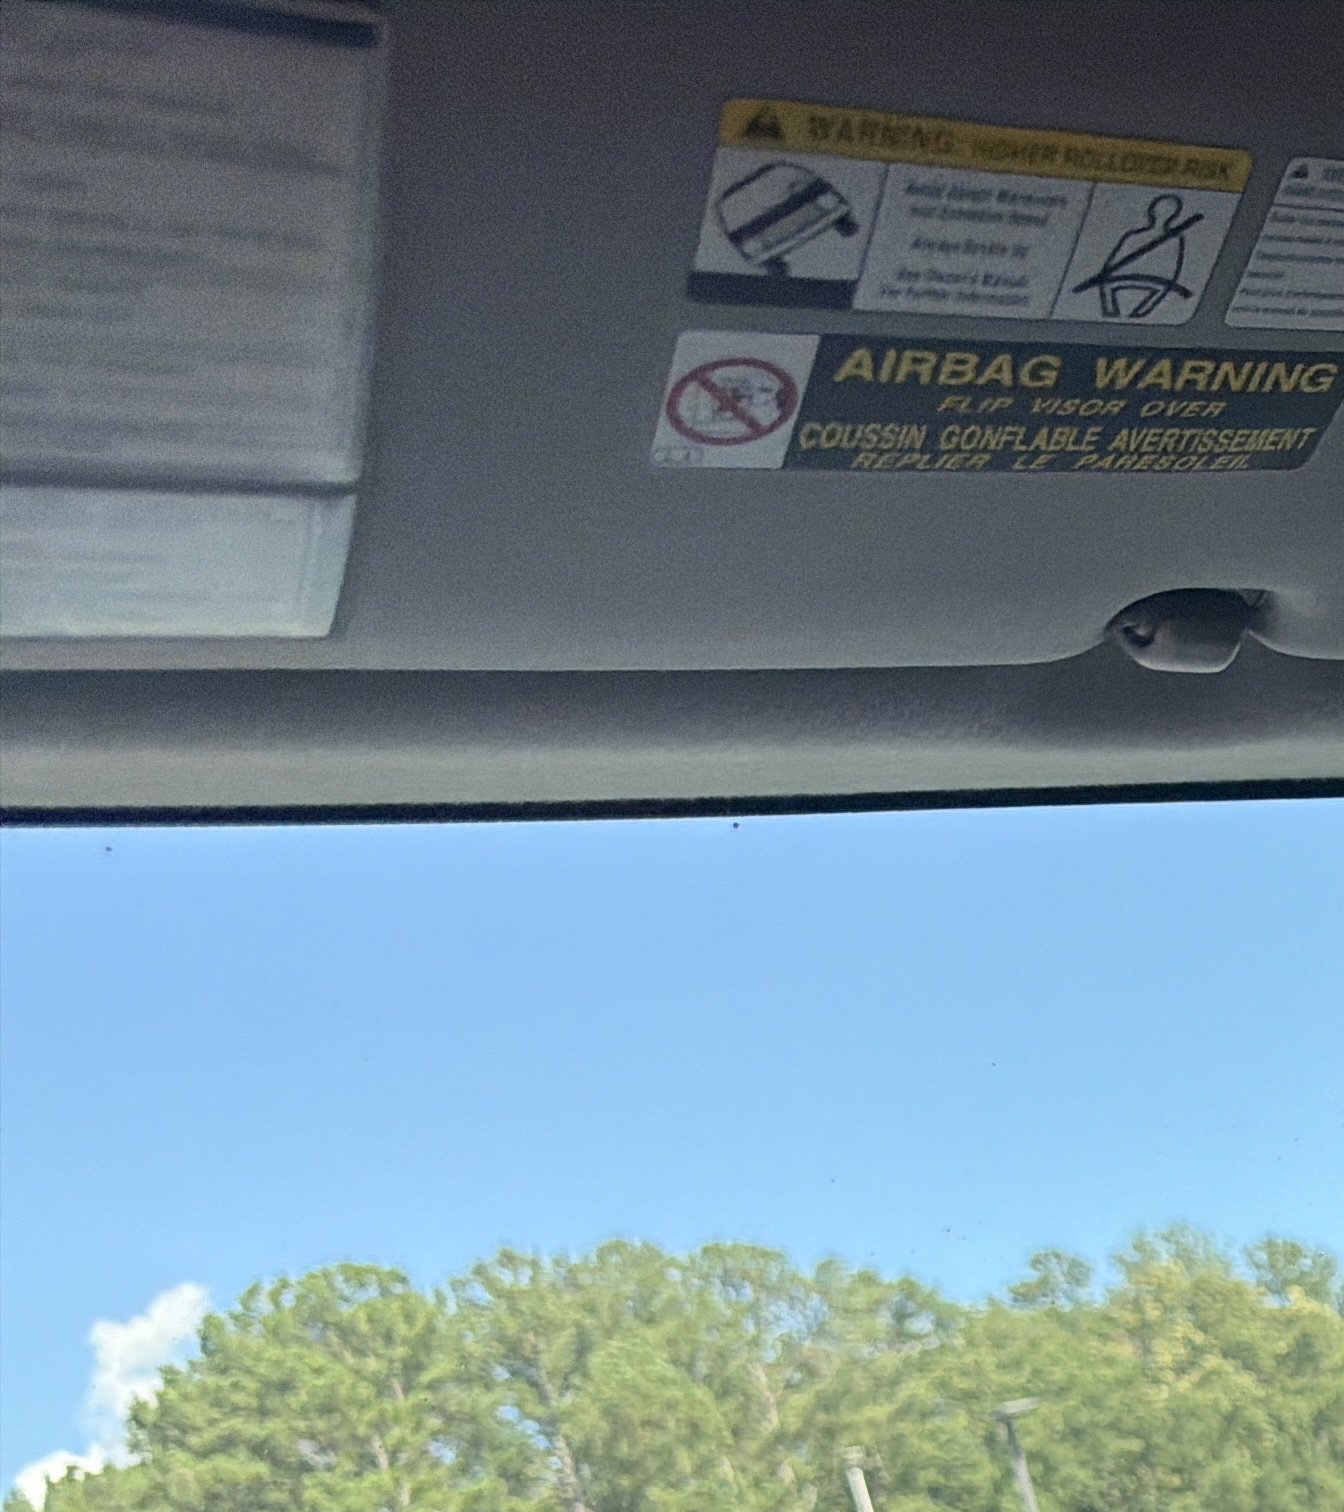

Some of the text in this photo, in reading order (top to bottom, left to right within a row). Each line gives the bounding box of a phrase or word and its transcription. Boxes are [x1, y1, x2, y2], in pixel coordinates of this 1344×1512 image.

[833, 347, 1339, 394] AIRBAG WARNING
[937, 394, 1228, 418] FLIP VISOR OVER
[799, 421, 1318, 454] COUSSIN GONFLABLE AVERTISSEMENT
[850, 451, 993, 470] REPLIER
[1012, 452, 1056, 471] LE
